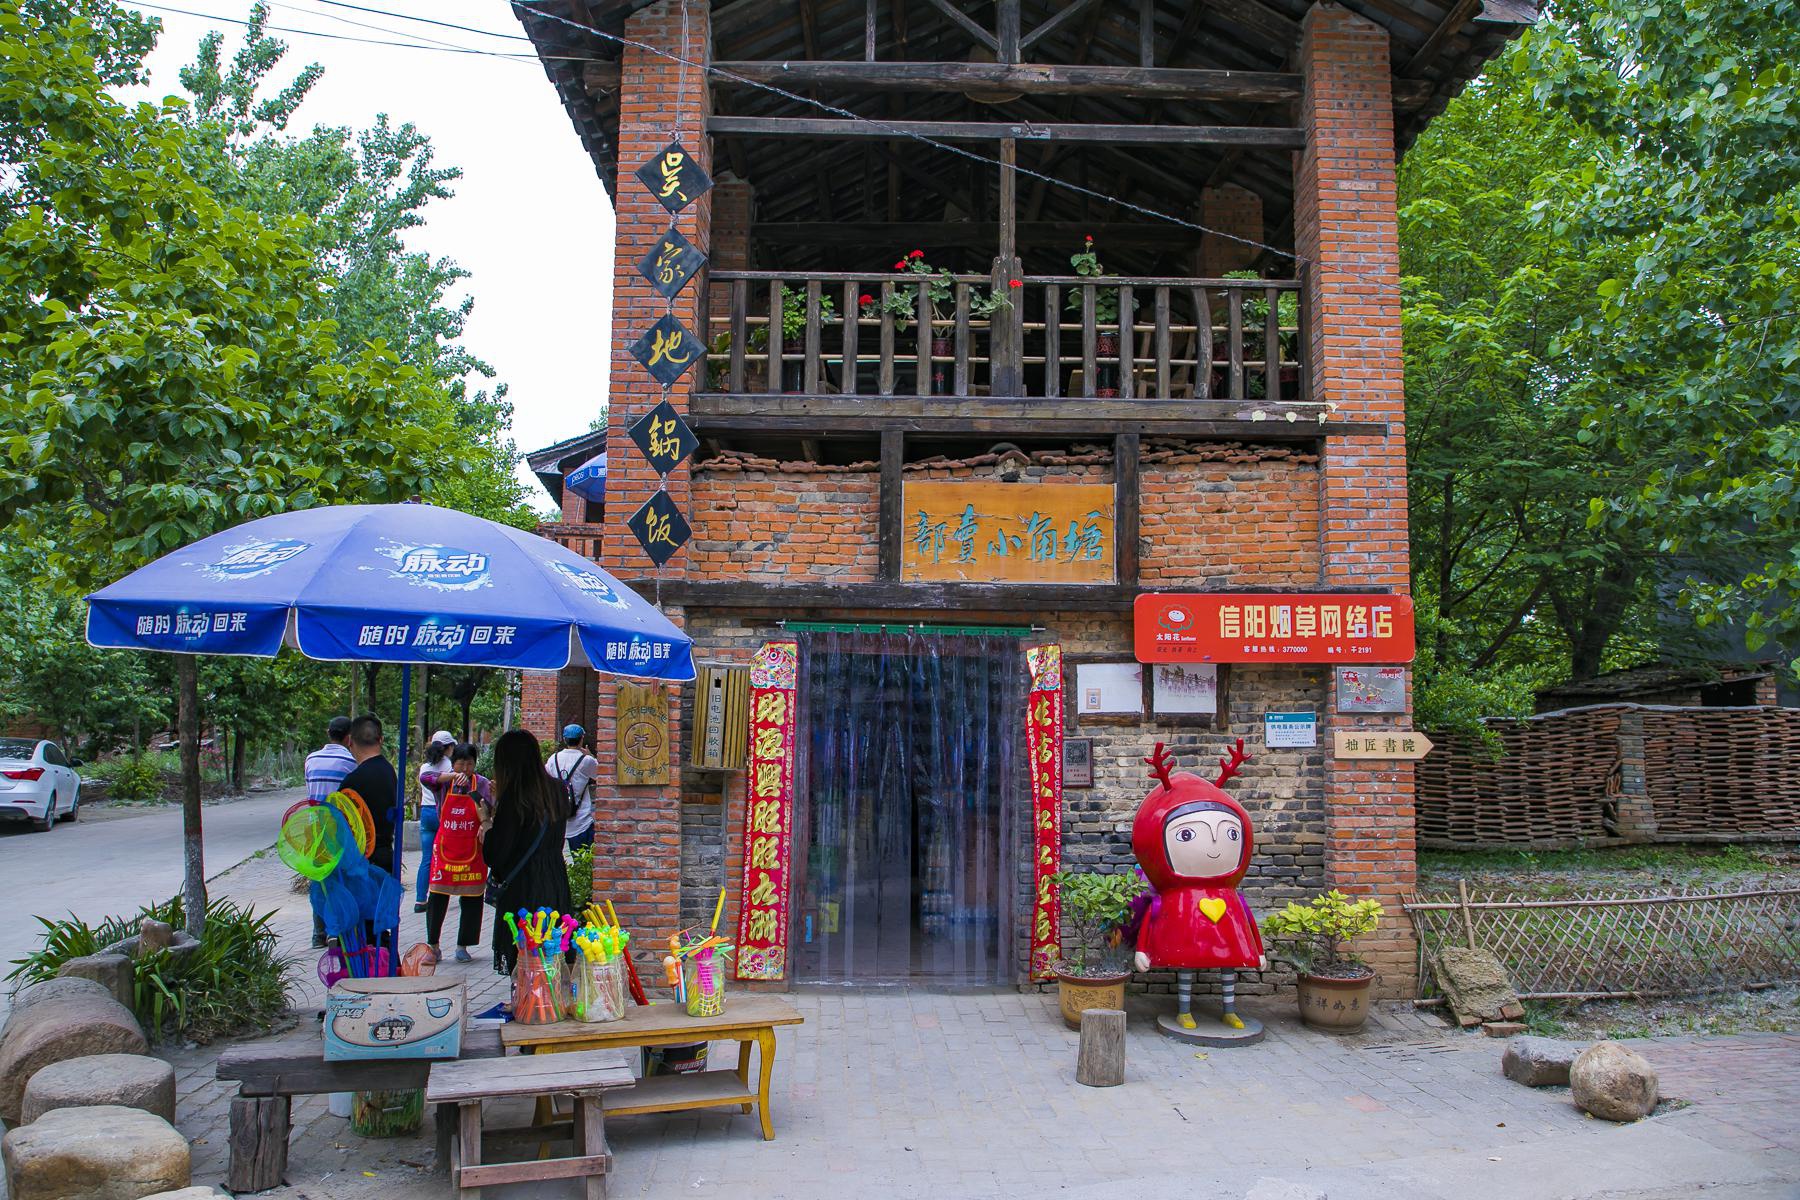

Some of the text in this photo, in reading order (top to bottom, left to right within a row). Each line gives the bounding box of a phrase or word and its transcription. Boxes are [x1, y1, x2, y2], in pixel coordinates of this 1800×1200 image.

[400, 553, 486, 576] 脉动
[1219, 604, 1393, 639] 信阳烟草网络店
[1156, 633, 1180, 641] 太阳花
[708, 694, 722, 758] 旧电池回收箱
[1303, 992, 1361, 1011] 吉祥如意
